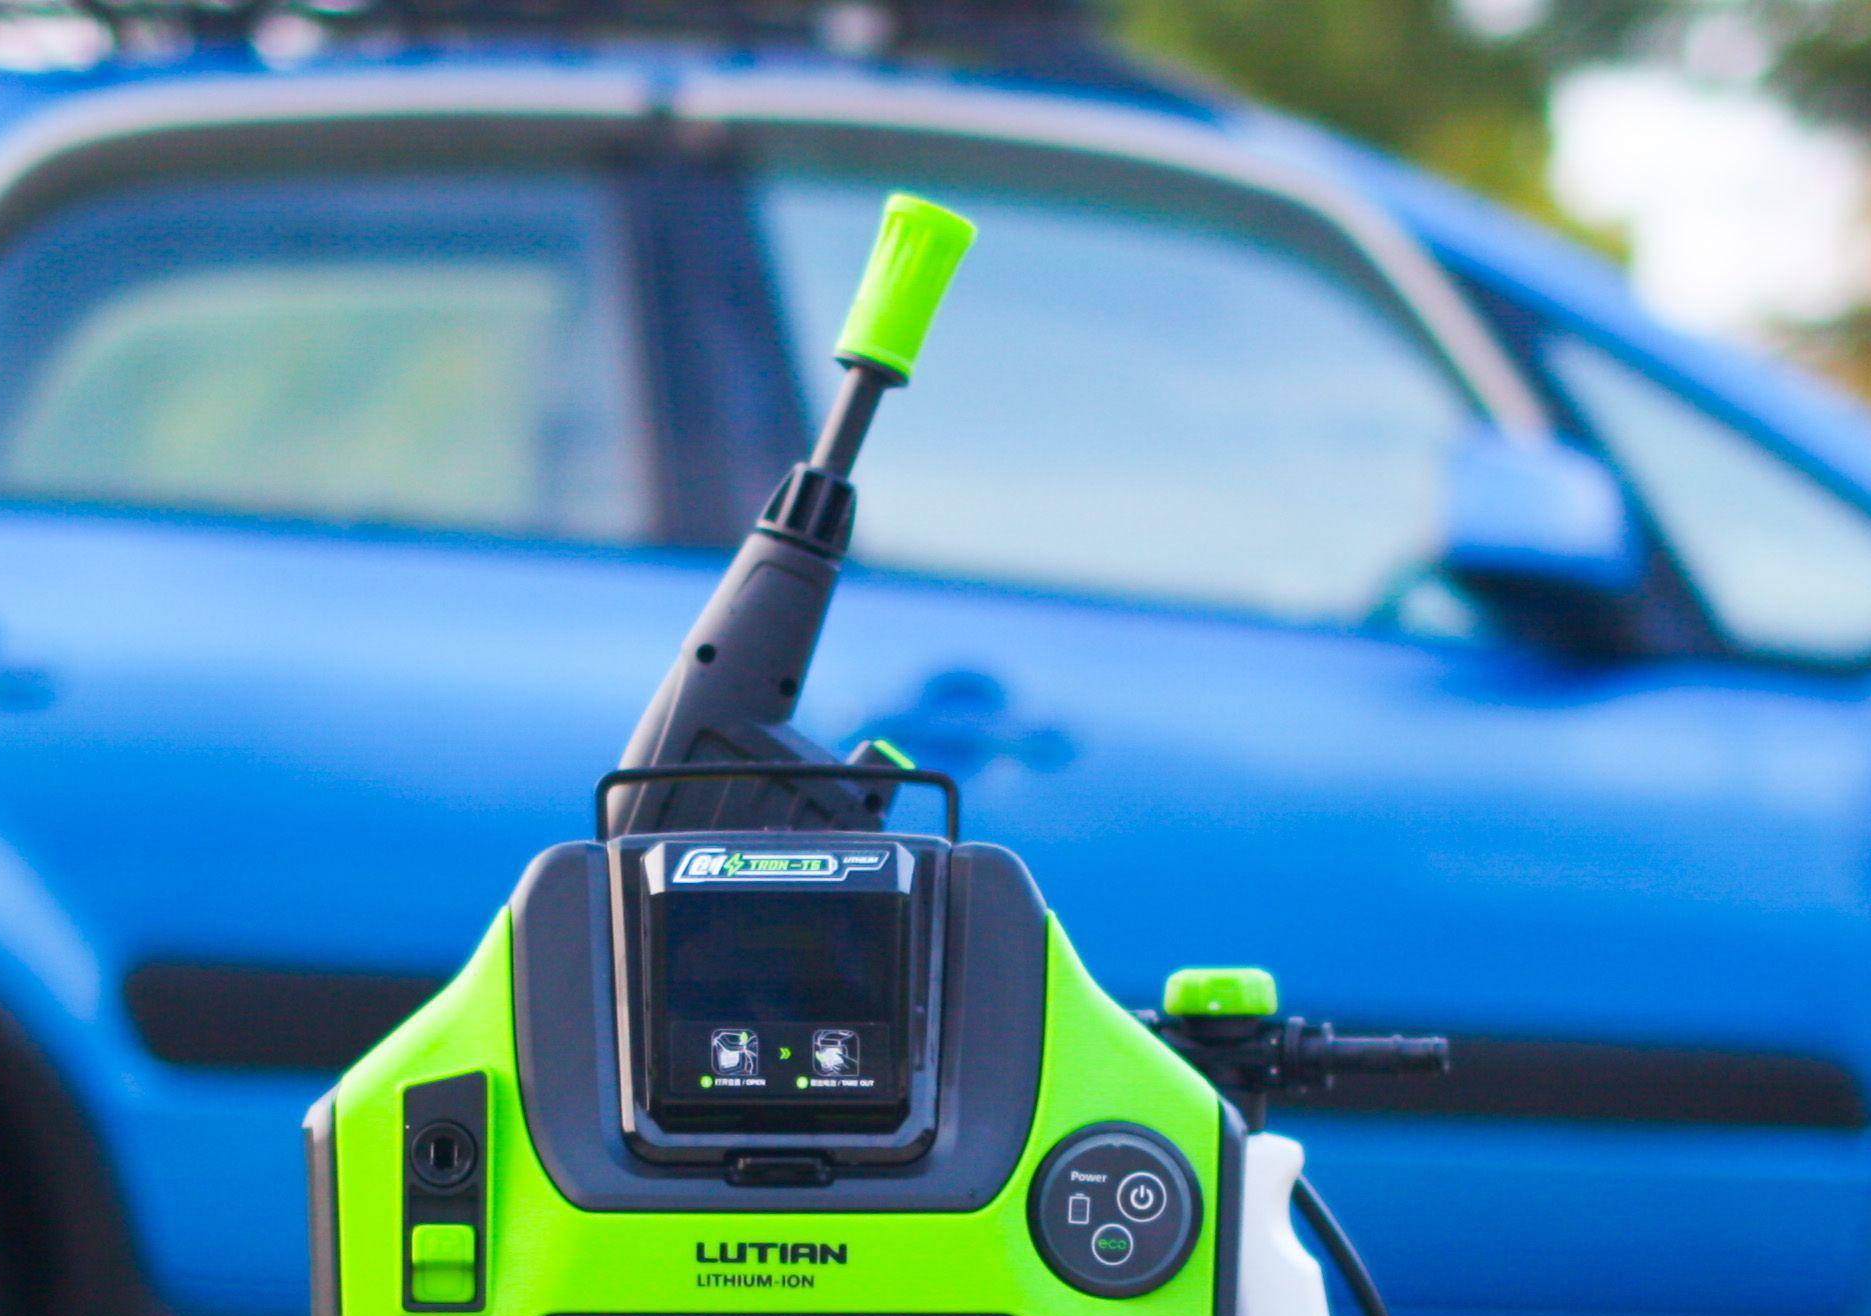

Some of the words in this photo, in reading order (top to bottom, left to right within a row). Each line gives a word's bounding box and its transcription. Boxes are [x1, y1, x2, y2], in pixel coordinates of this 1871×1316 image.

[1070, 1170, 1108, 1183] Power
[1097, 1238, 1127, 1250] eco
[695, 1242, 848, 1264] LUTIAN
[696, 1273, 815, 1288] LITHIUM-ION
